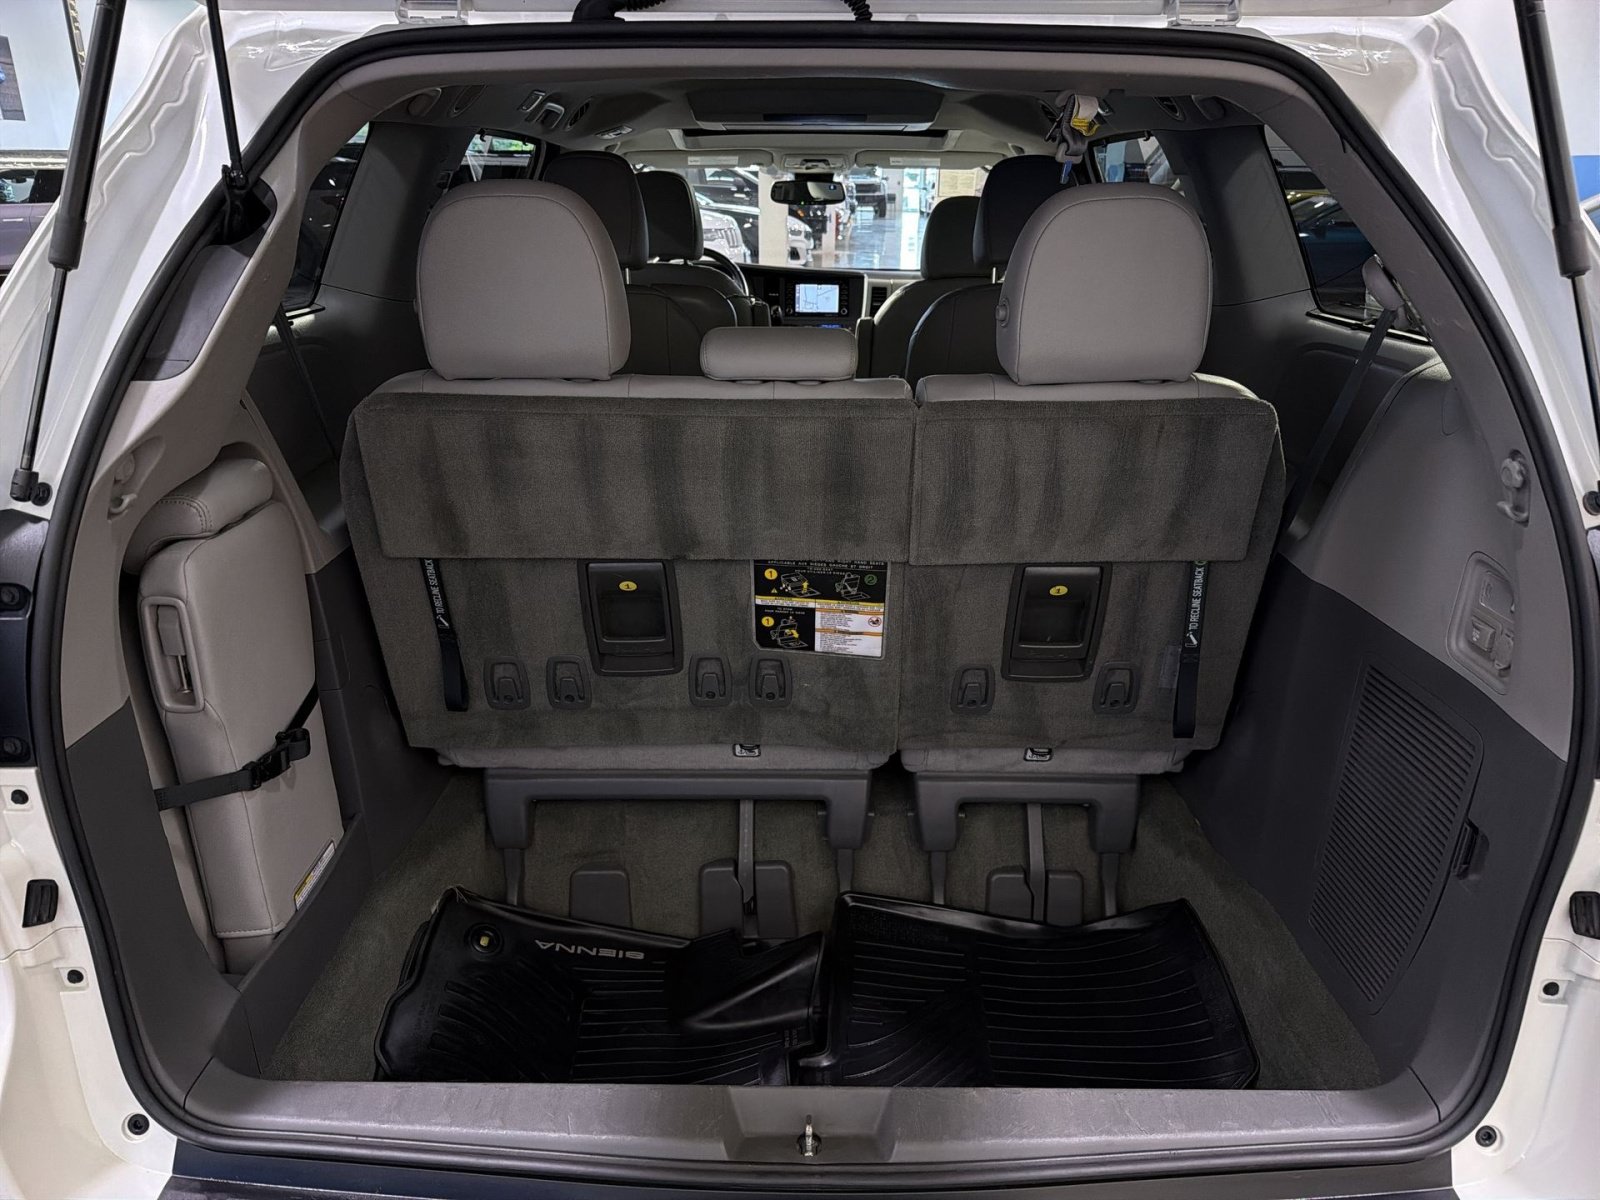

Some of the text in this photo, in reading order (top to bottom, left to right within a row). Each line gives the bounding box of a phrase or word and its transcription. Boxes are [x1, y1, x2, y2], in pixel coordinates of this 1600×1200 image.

[424, 559, 438, 586] SEATBACK
[430, 586, 443, 607] RECLINE
[1189, 566, 1204, 630] TO RECLINE SEATBACK
[534, 939, 646, 960] SIENNA
